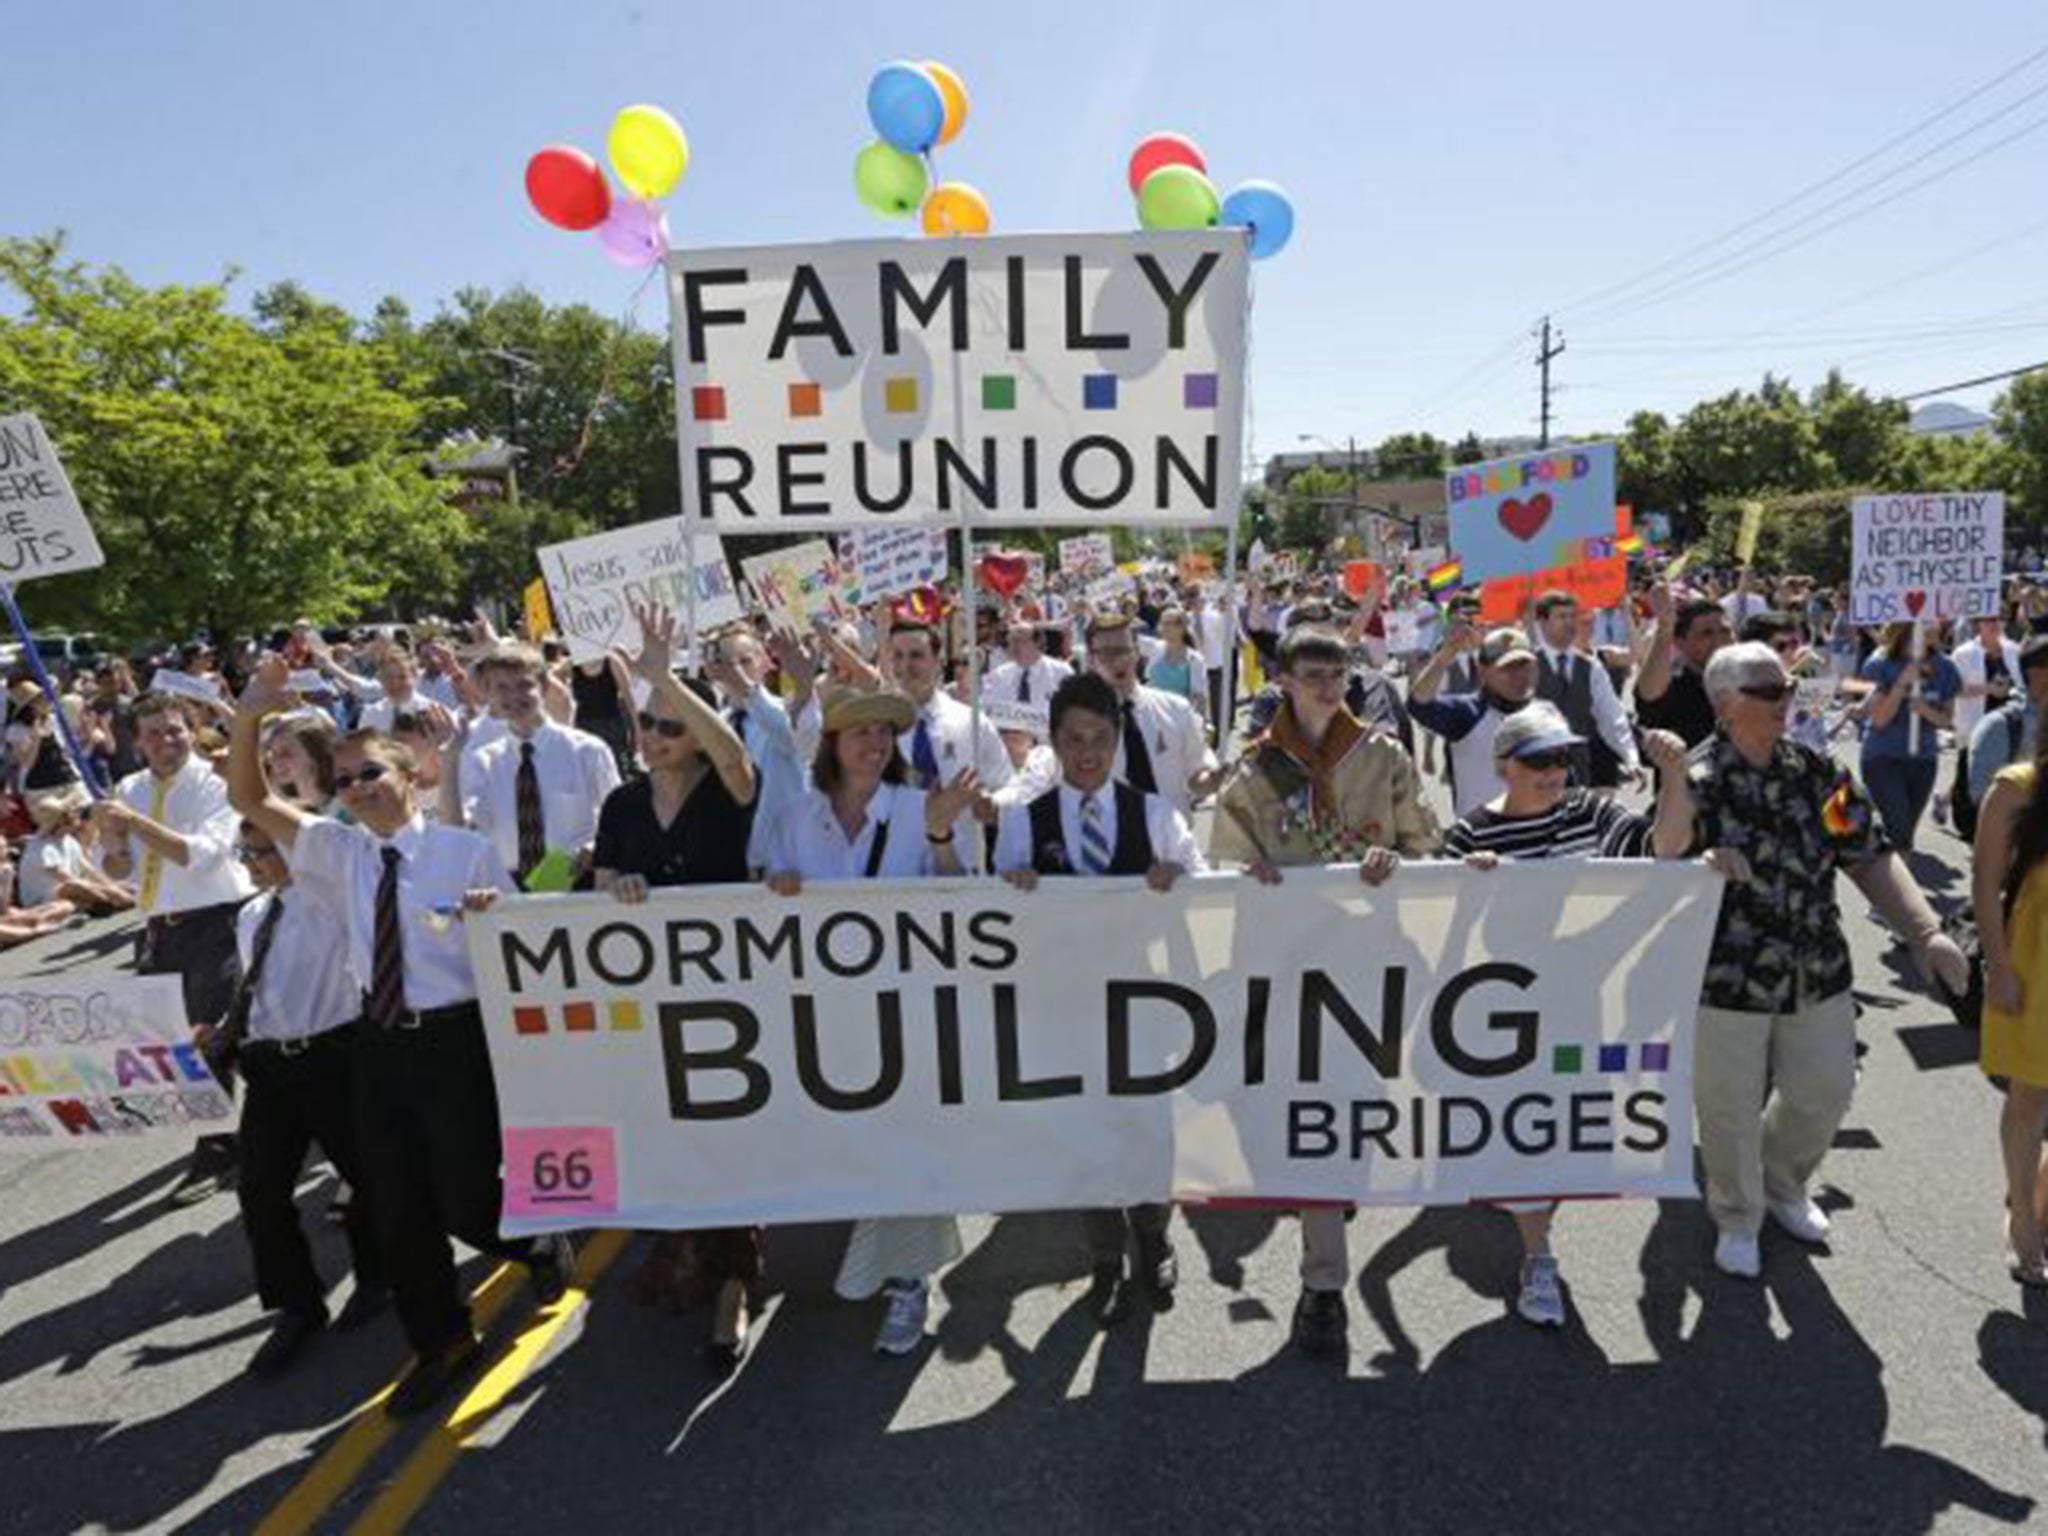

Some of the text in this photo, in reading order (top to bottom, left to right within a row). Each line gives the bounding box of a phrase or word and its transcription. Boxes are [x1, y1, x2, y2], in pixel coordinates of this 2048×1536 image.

[683, 253, 1220, 363] FAMILY
[696, 435, 1218, 518] REUNION
[1871, 496, 1987, 525] LOVE THY
[1868, 526, 1986, 557] NEIGHBOR
[553, 552, 626, 590] Jesus
[1855, 556, 1997, 588] AS THYSELF
[1853, 588, 1997, 621] LDS LGBT
[500, 911, 1018, 993] MORMONS
[658, 963, 1541, 1121] BUILDING
[1287, 1092, 1669, 1161] BRIDGES
[533, 1149, 593, 1193] 66
